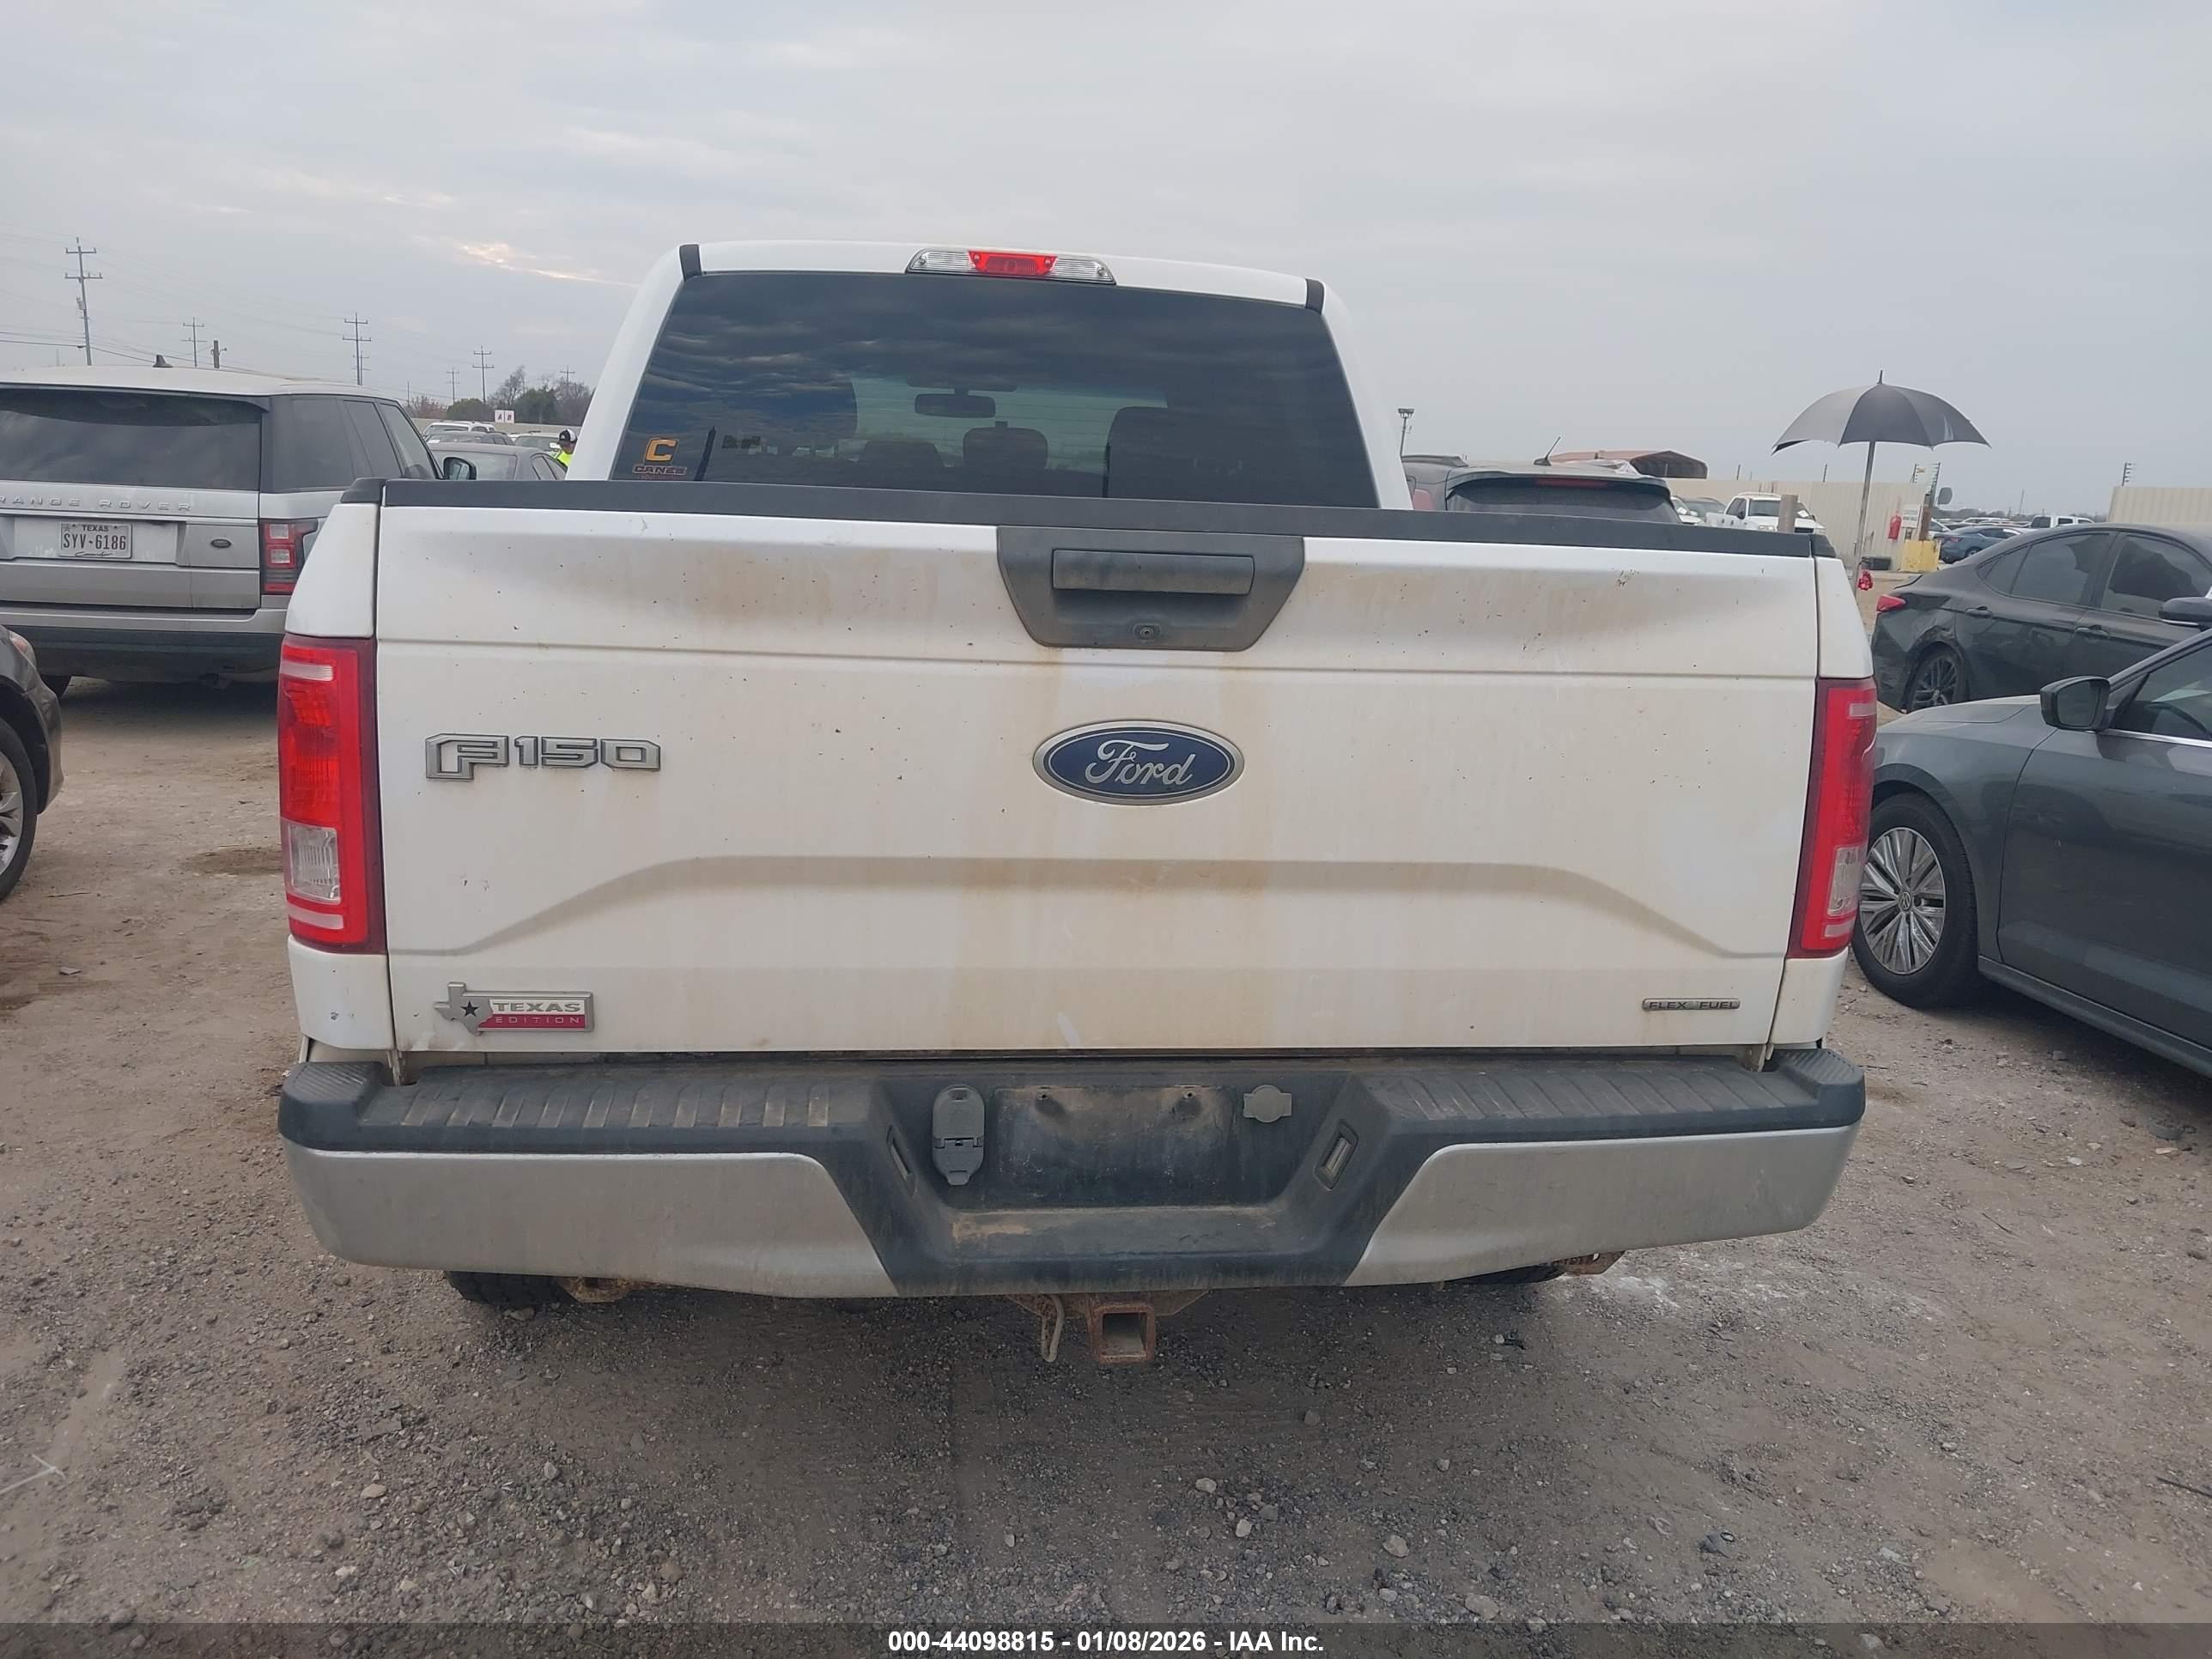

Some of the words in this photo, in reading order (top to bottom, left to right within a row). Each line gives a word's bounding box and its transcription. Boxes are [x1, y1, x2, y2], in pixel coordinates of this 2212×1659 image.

[645, 438, 679, 462] C
[99, 500, 191, 512] ROVER
[1085, 739, 1196, 785] Ford
[493, 1002, 581, 1012] TEXAS
[1649, 1001, 1687, 1010] FLEX
[1699, 1001, 1739, 1010] FUEL
